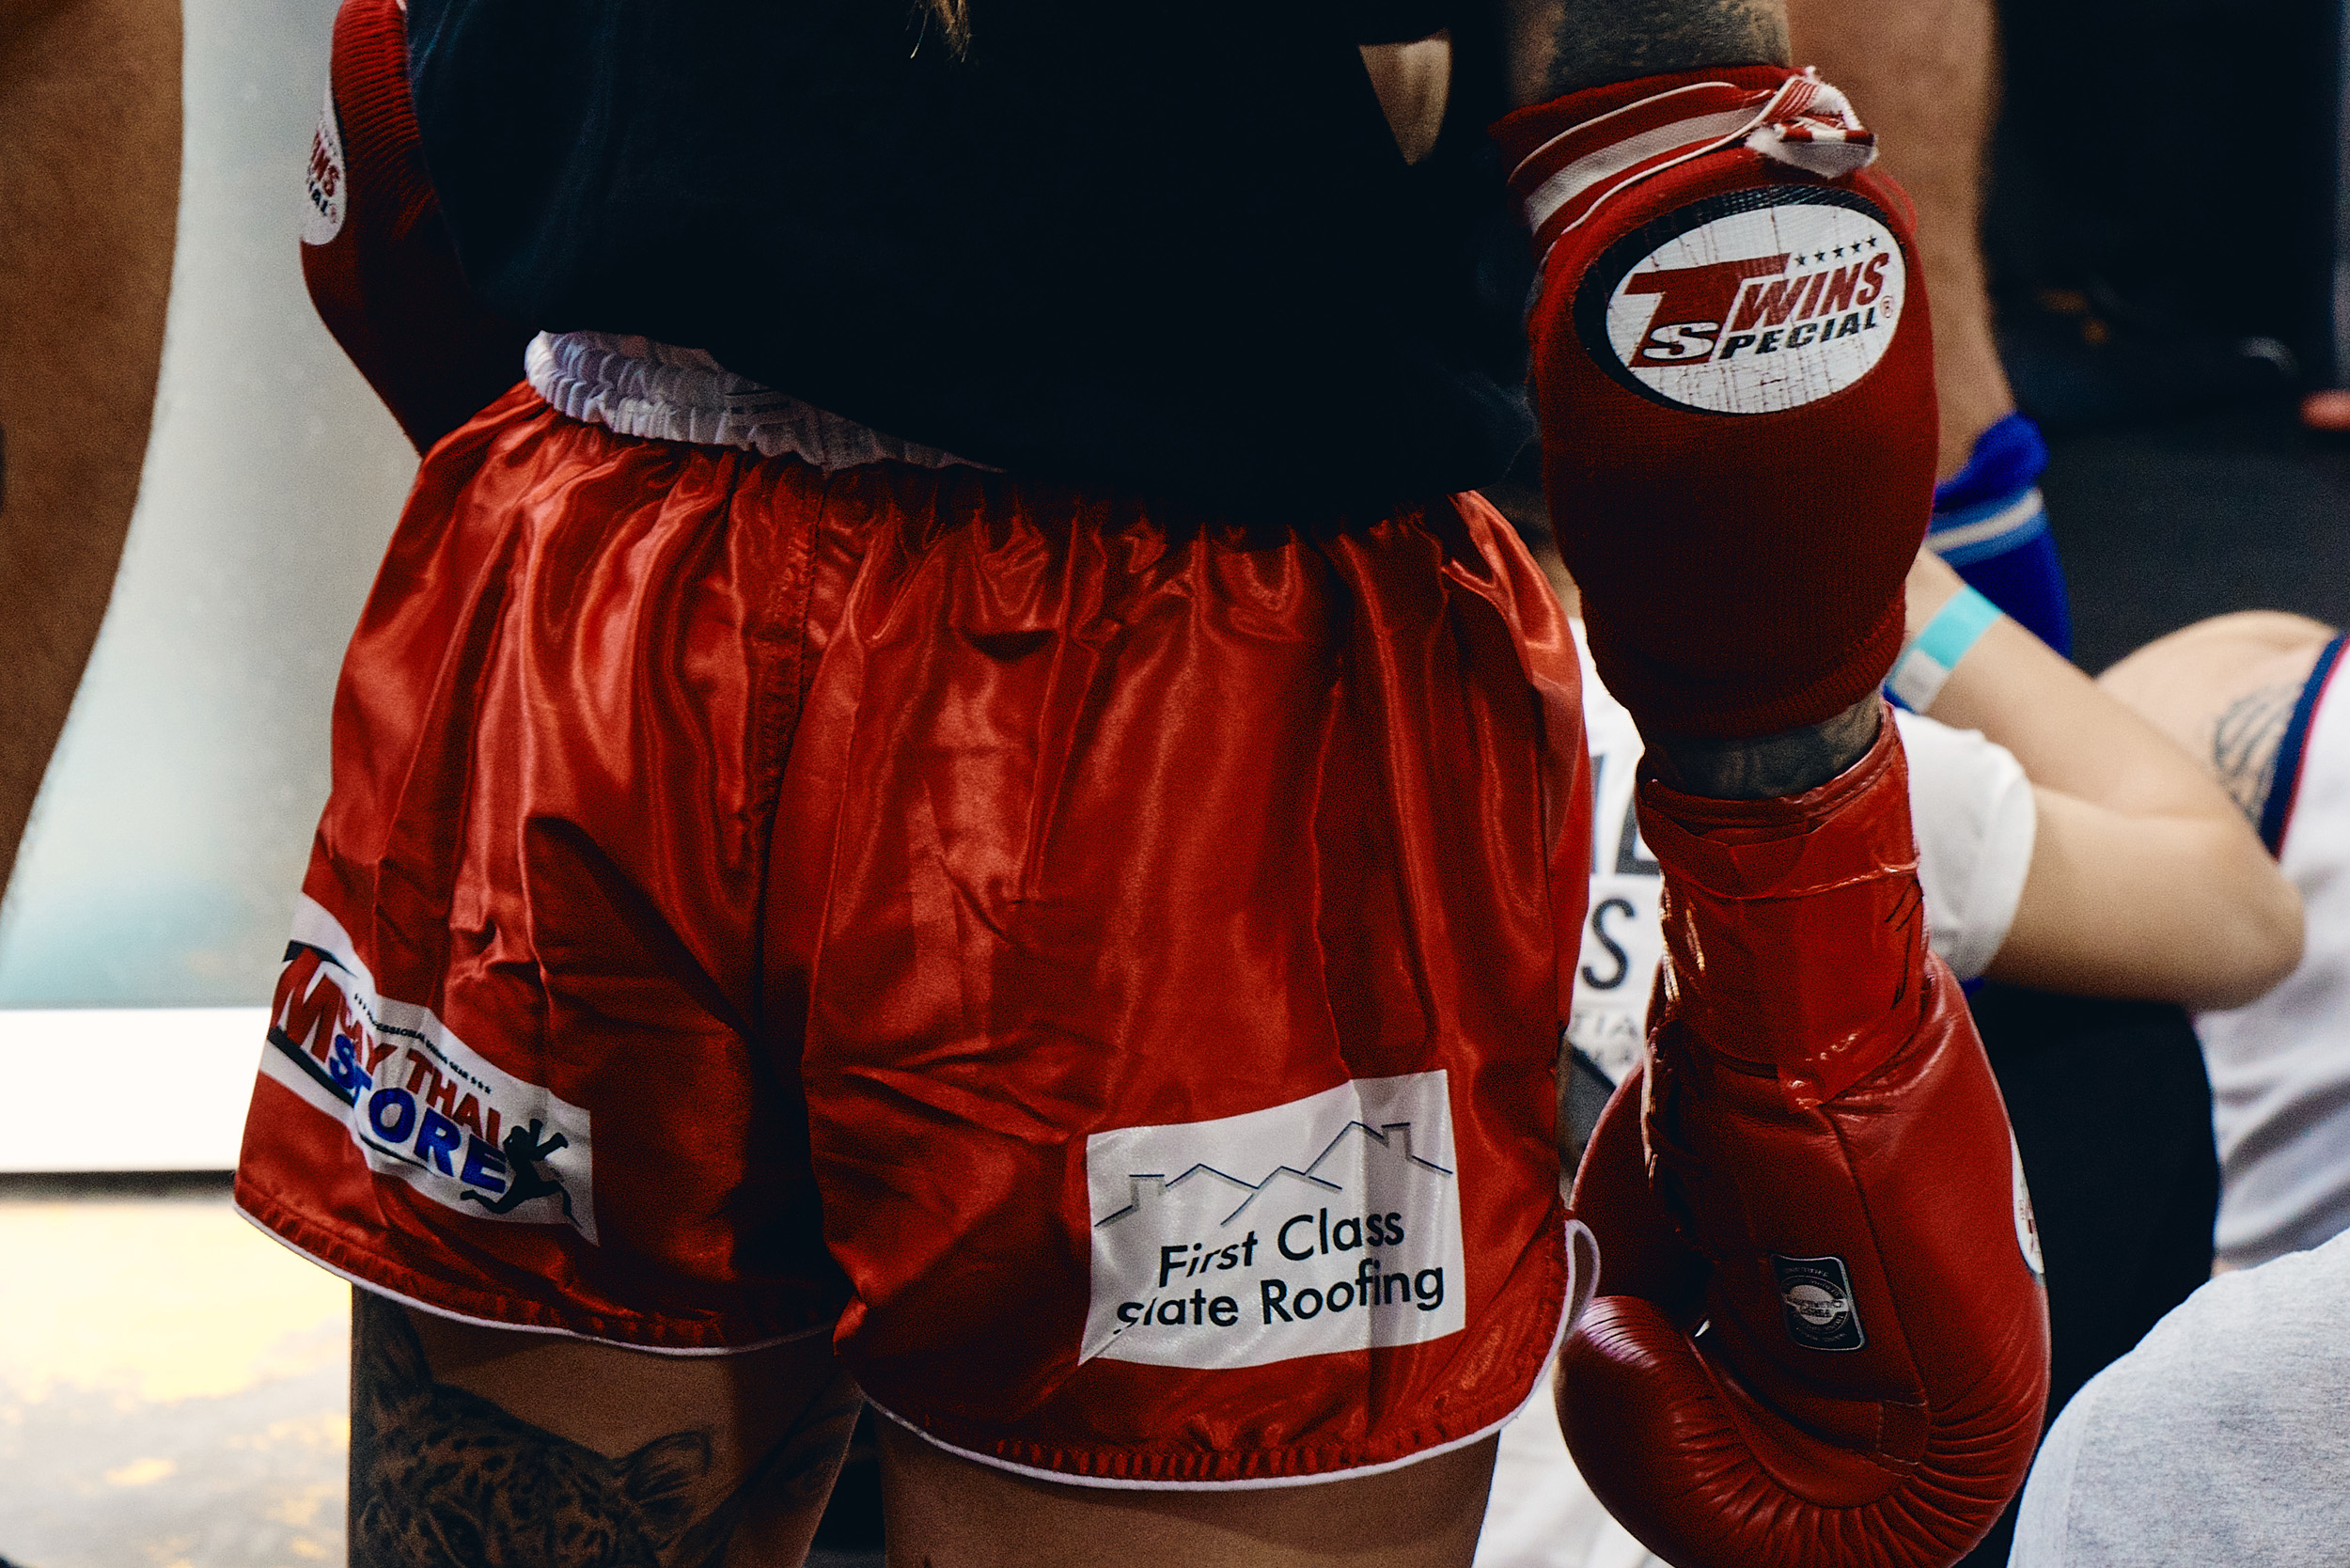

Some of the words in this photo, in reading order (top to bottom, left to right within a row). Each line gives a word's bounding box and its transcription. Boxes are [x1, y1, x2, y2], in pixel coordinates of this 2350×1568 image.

[1623, 252, 1890, 368] TWINS
[1643, 306, 1876, 360] SPECIAL
[329, 1034, 507, 1194] STORE
[405, 1047, 501, 1150] THAI
[1158, 1231, 1259, 1288] First
[1277, 1208, 1405, 1262] Class
[1261, 1258, 1445, 1325] Roofing
